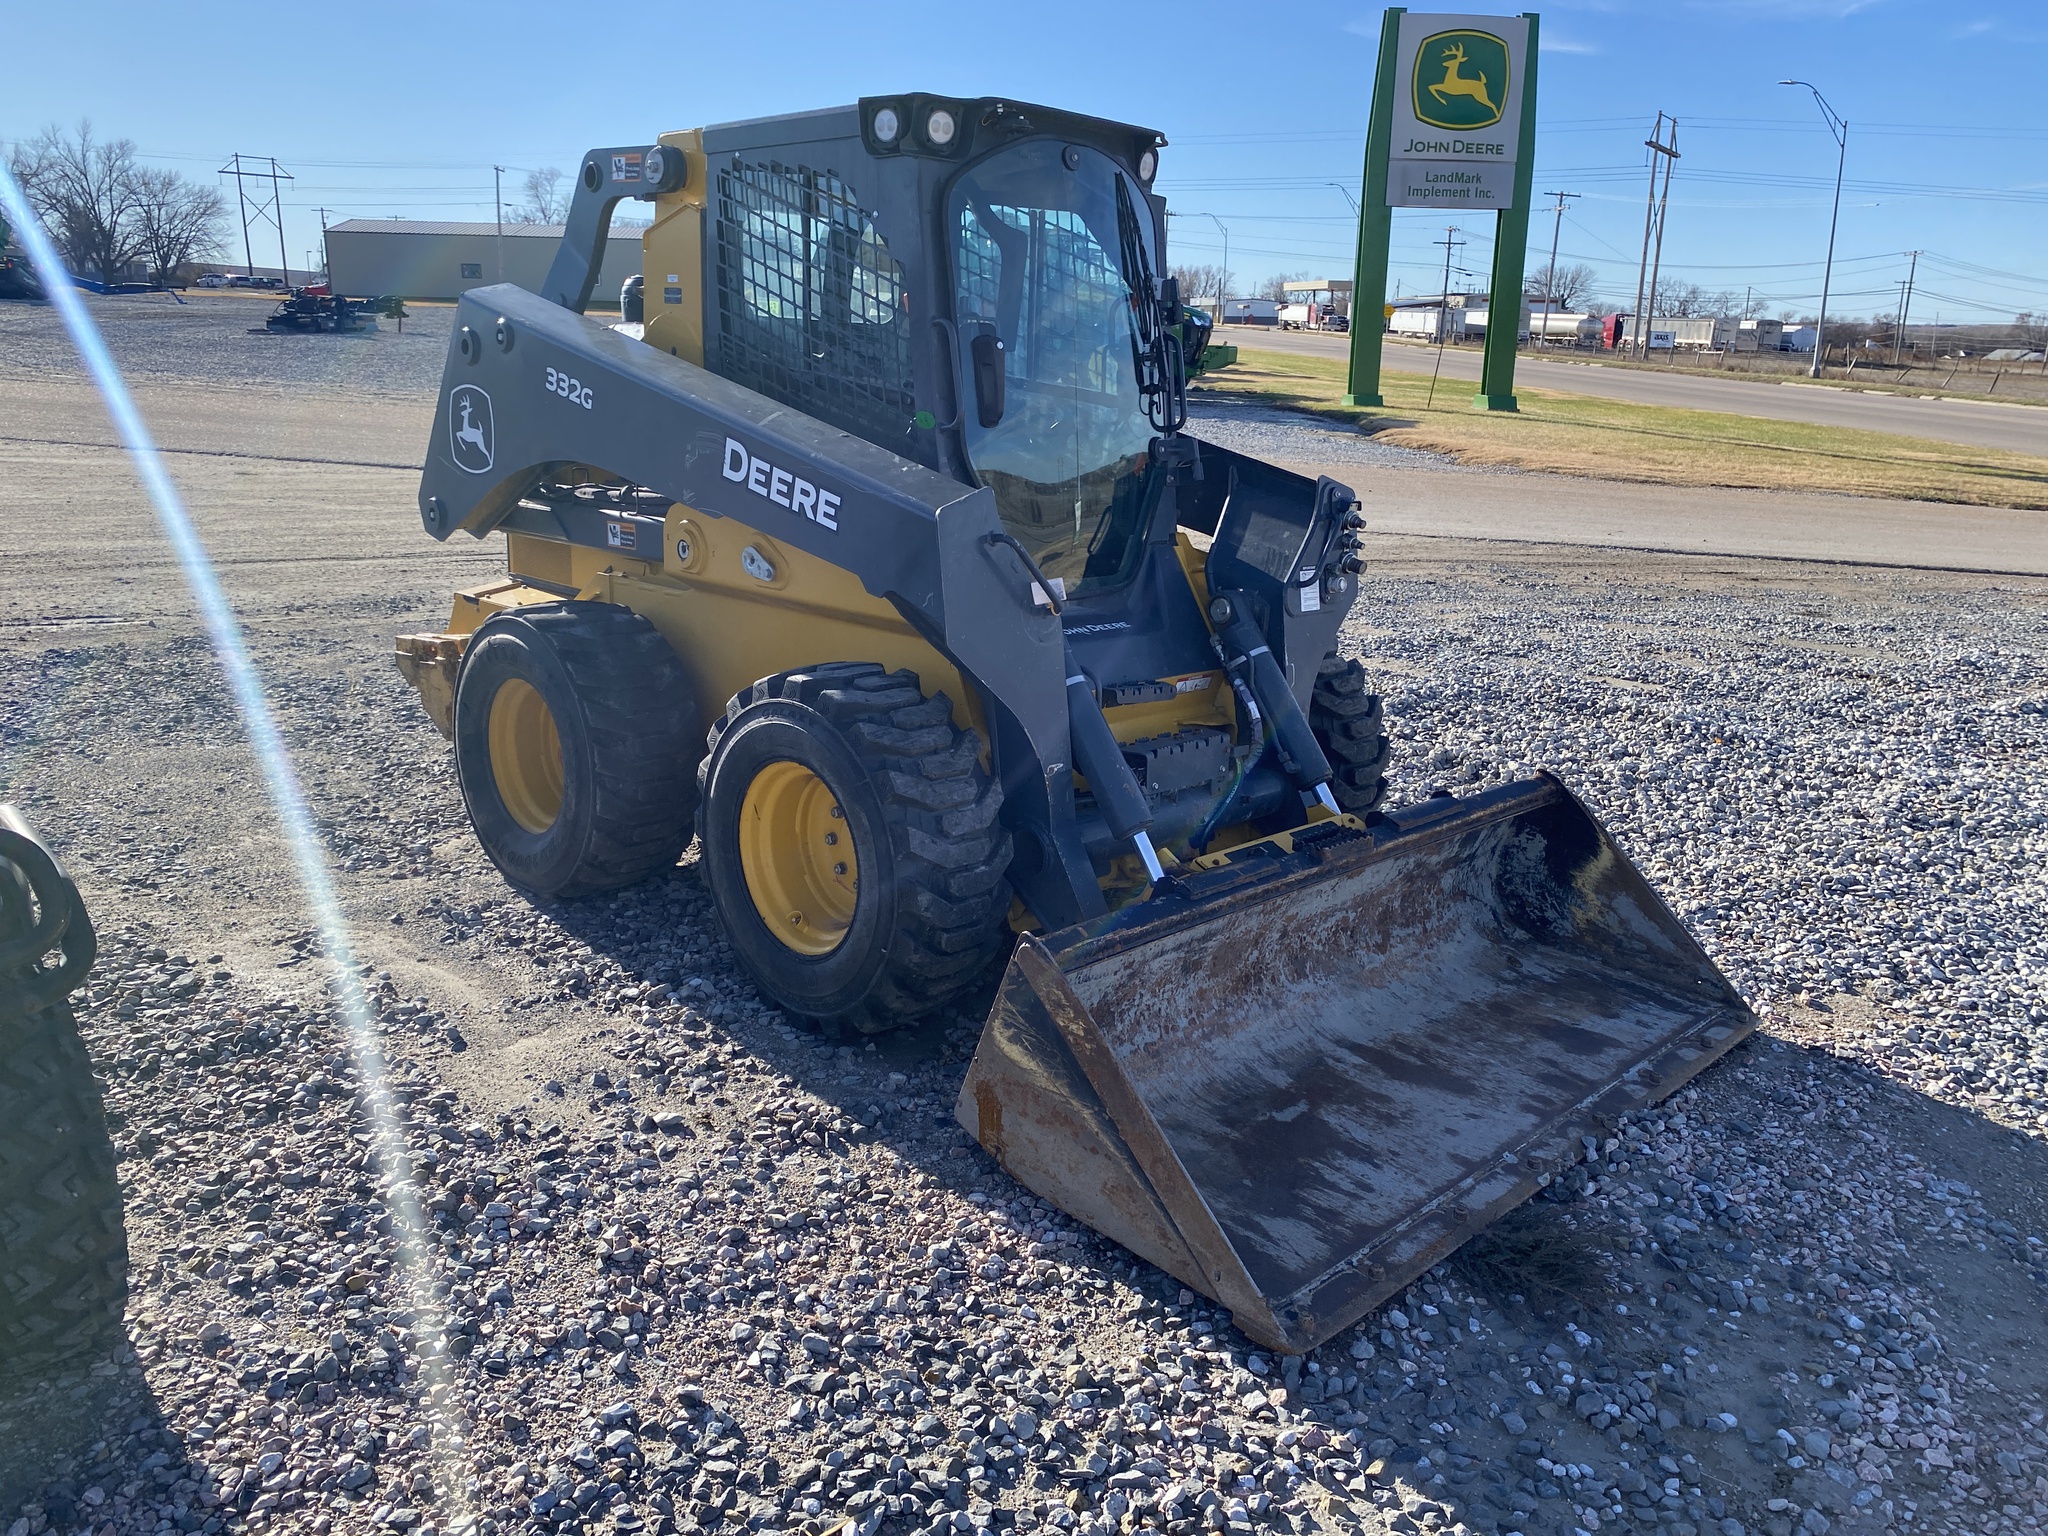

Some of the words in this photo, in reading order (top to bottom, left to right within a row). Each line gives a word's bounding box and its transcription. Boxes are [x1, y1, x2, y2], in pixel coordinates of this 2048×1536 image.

[1403, 139, 1450, 153] JOHN
[1452, 140, 1505, 155] DEERE
[1425, 171, 1482, 184] LandMark
[1407, 185, 1471, 199] Implement
[1474, 187, 1495, 199] Inc.
[545, 366, 593, 410] 332G
[722, 436, 842, 532] DEERE
[1063, 626, 1091, 636] OHN
[1085, 621, 1131, 632] DEERE
